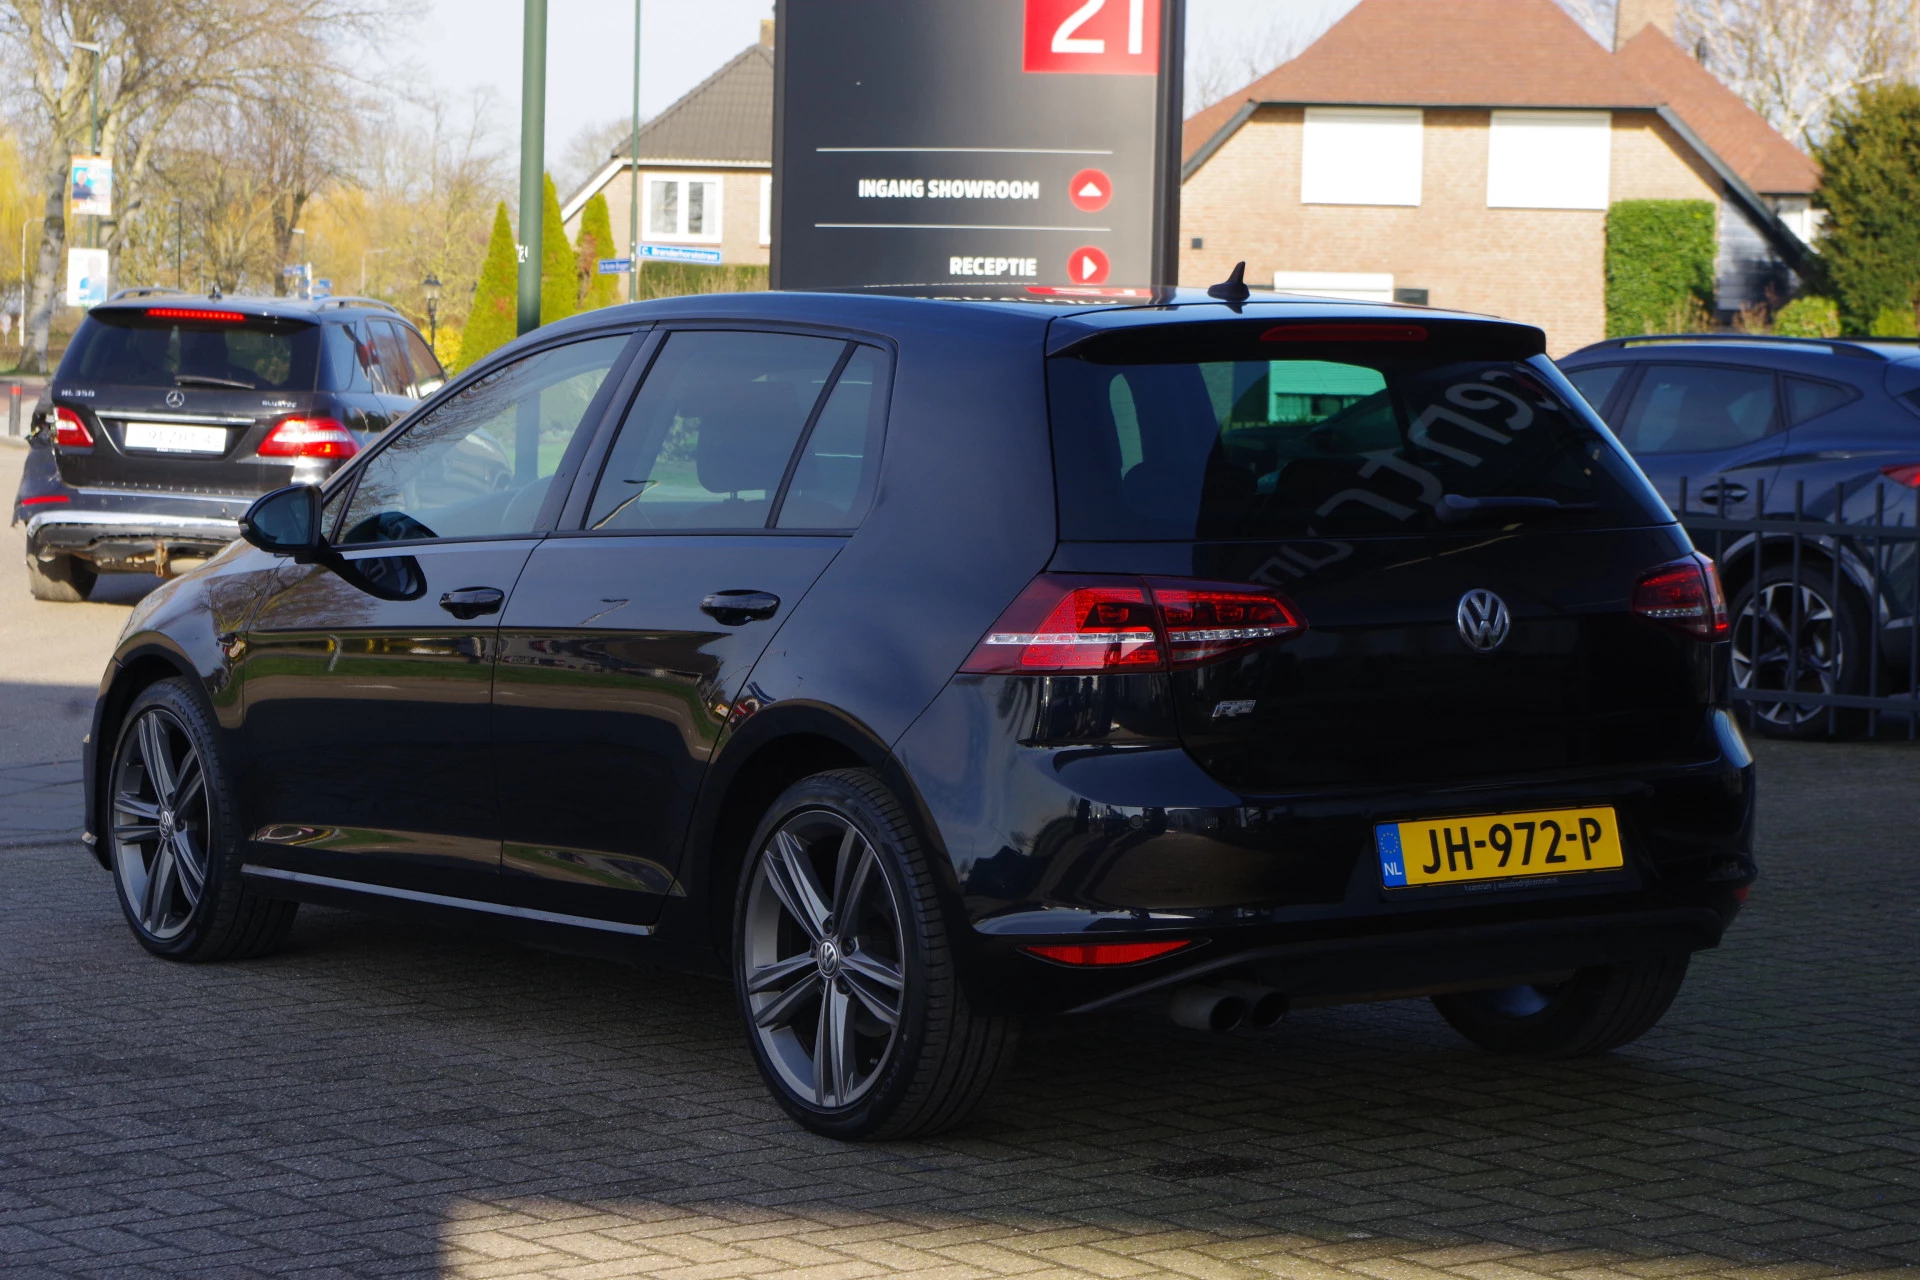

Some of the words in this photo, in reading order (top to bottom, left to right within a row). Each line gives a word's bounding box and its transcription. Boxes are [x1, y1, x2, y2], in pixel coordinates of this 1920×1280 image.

[1050, 0, 1144, 55] 21
[858, 179, 924, 199] INGANG
[928, 179, 1039, 200] SHOWROOM
[949, 256, 1037, 277] RECEPTIE
[1422, 817, 1602, 875] JH-972-P
[1383, 861, 1403, 877] NL
